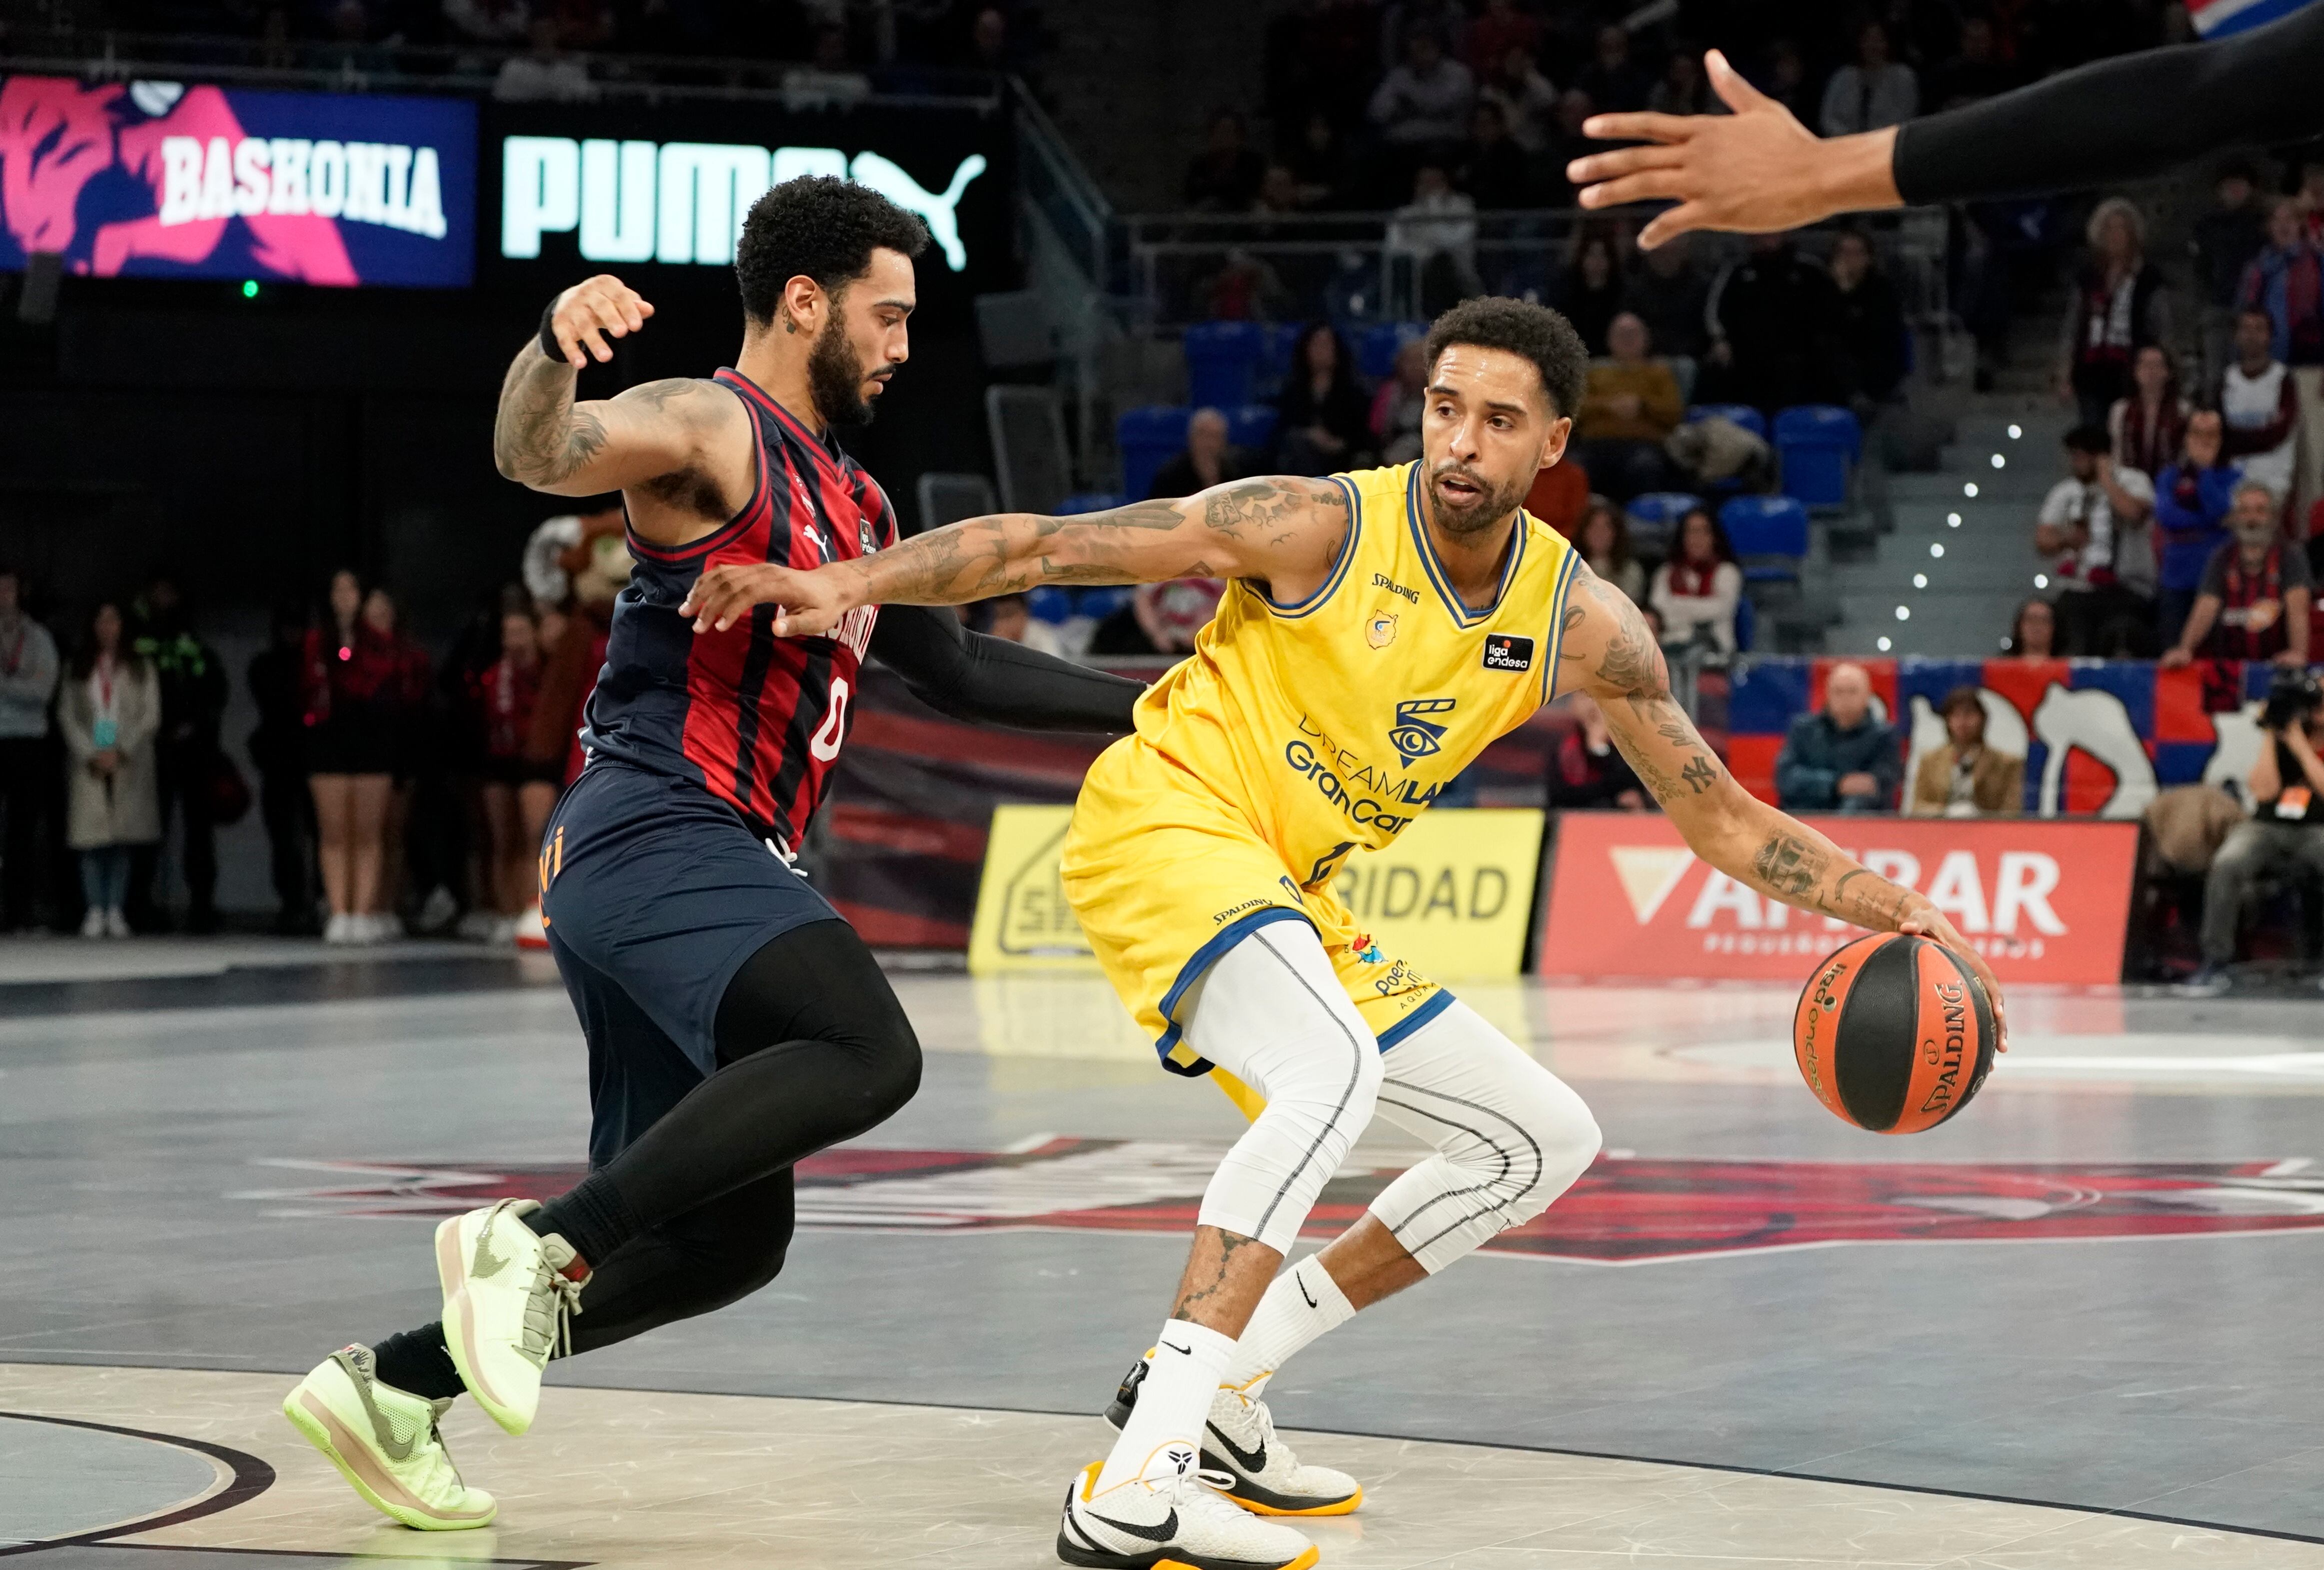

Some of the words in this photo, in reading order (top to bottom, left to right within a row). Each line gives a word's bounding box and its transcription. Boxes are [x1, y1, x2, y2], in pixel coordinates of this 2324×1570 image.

[160, 136, 447, 240] BASKONIA
[501, 135, 849, 266] PUM
[1371, 572, 1420, 604] SPALDING
[1487, 656, 1528, 668] endesa
[1488, 644, 1508, 657] liga
[810, 676, 849, 762] 0
[1298, 712, 1450, 804] DREAMLA
[1813, 961, 1847, 1004] liga
[1805, 1007, 1831, 1104] endesa
[1919, 982, 1964, 1114] SPALDING
